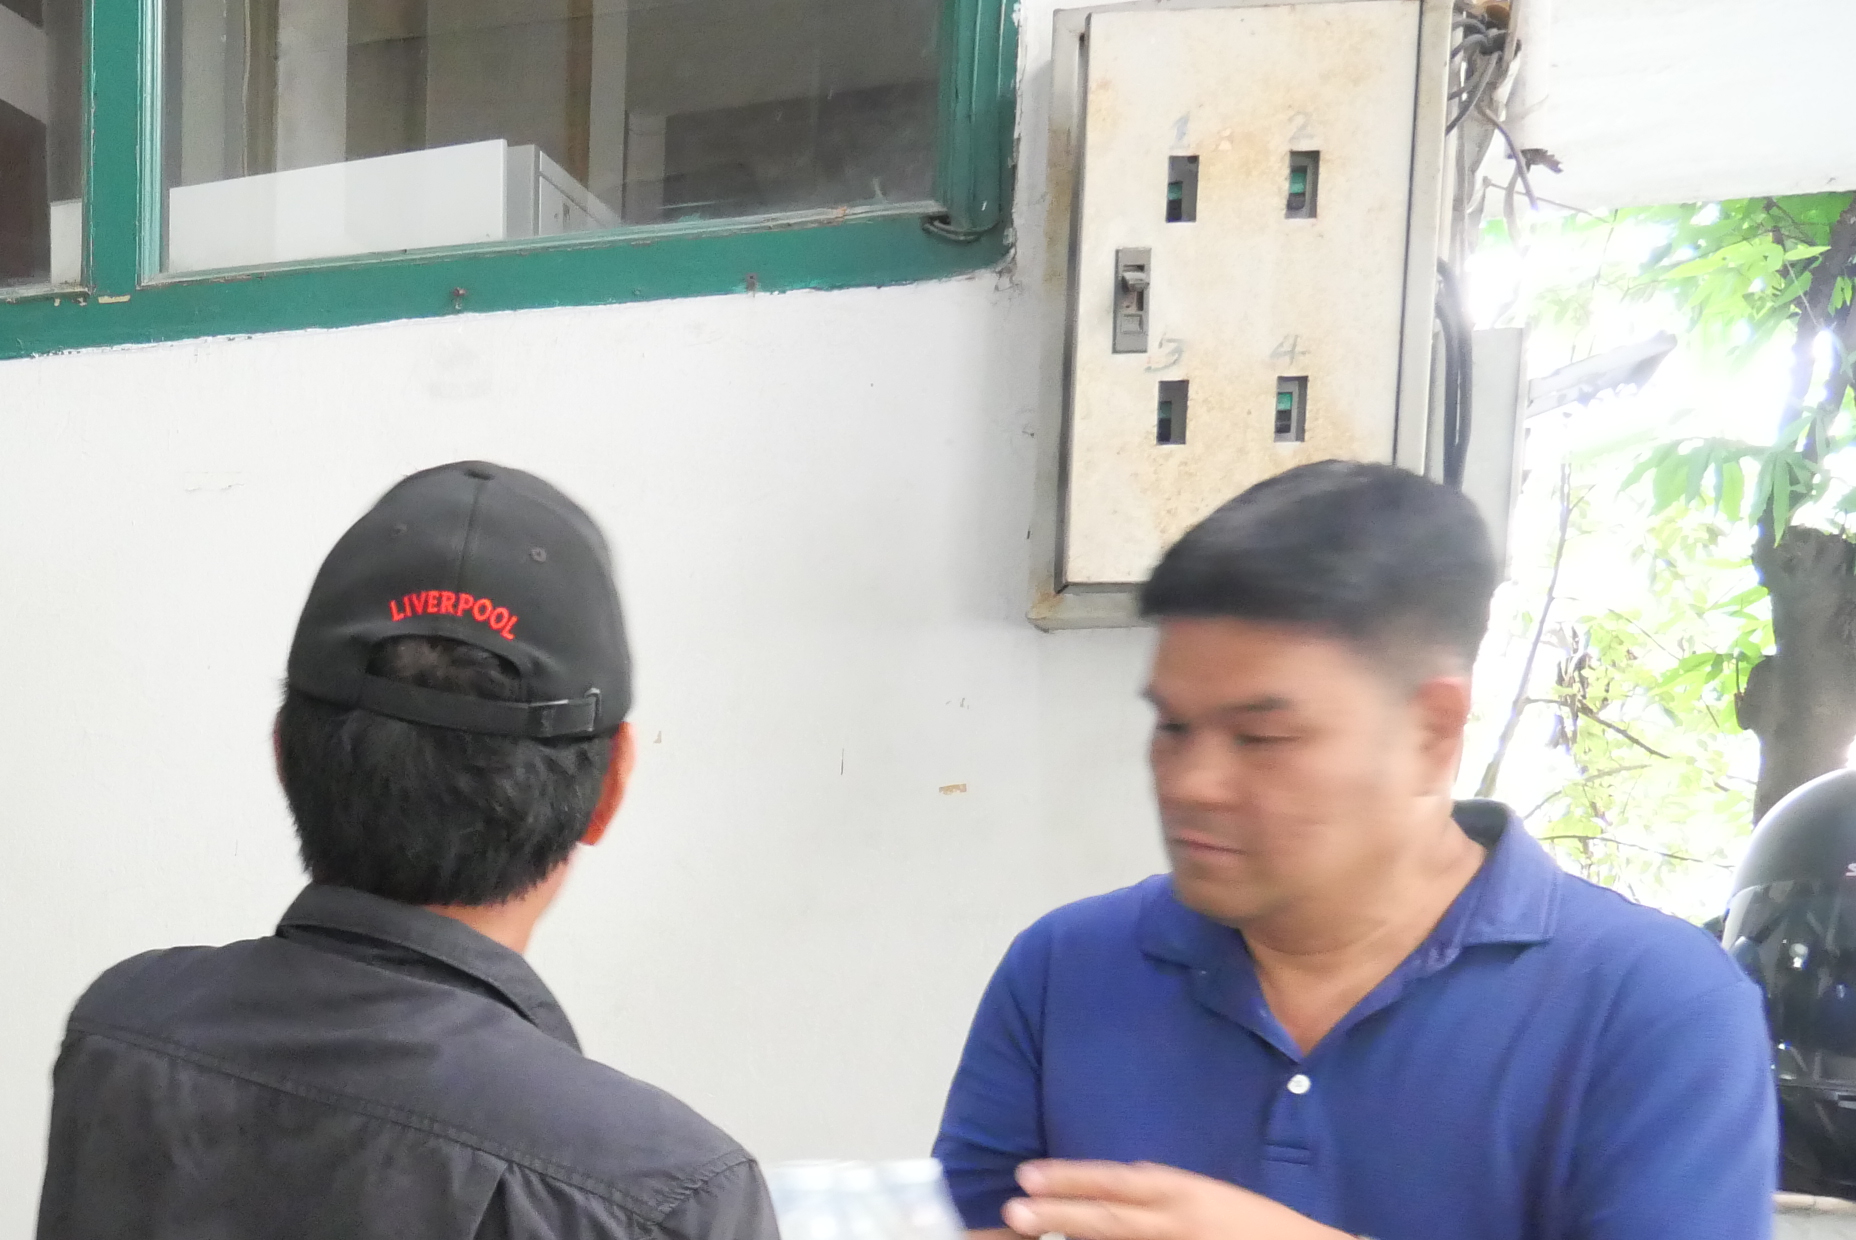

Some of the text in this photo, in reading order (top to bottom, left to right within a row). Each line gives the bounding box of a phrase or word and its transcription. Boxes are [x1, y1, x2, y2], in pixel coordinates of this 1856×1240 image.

[1170, 110, 1315, 150] 1 2
[1269, 334, 1310, 367] 4
[389, 590, 519, 640] LIVERPOOL
